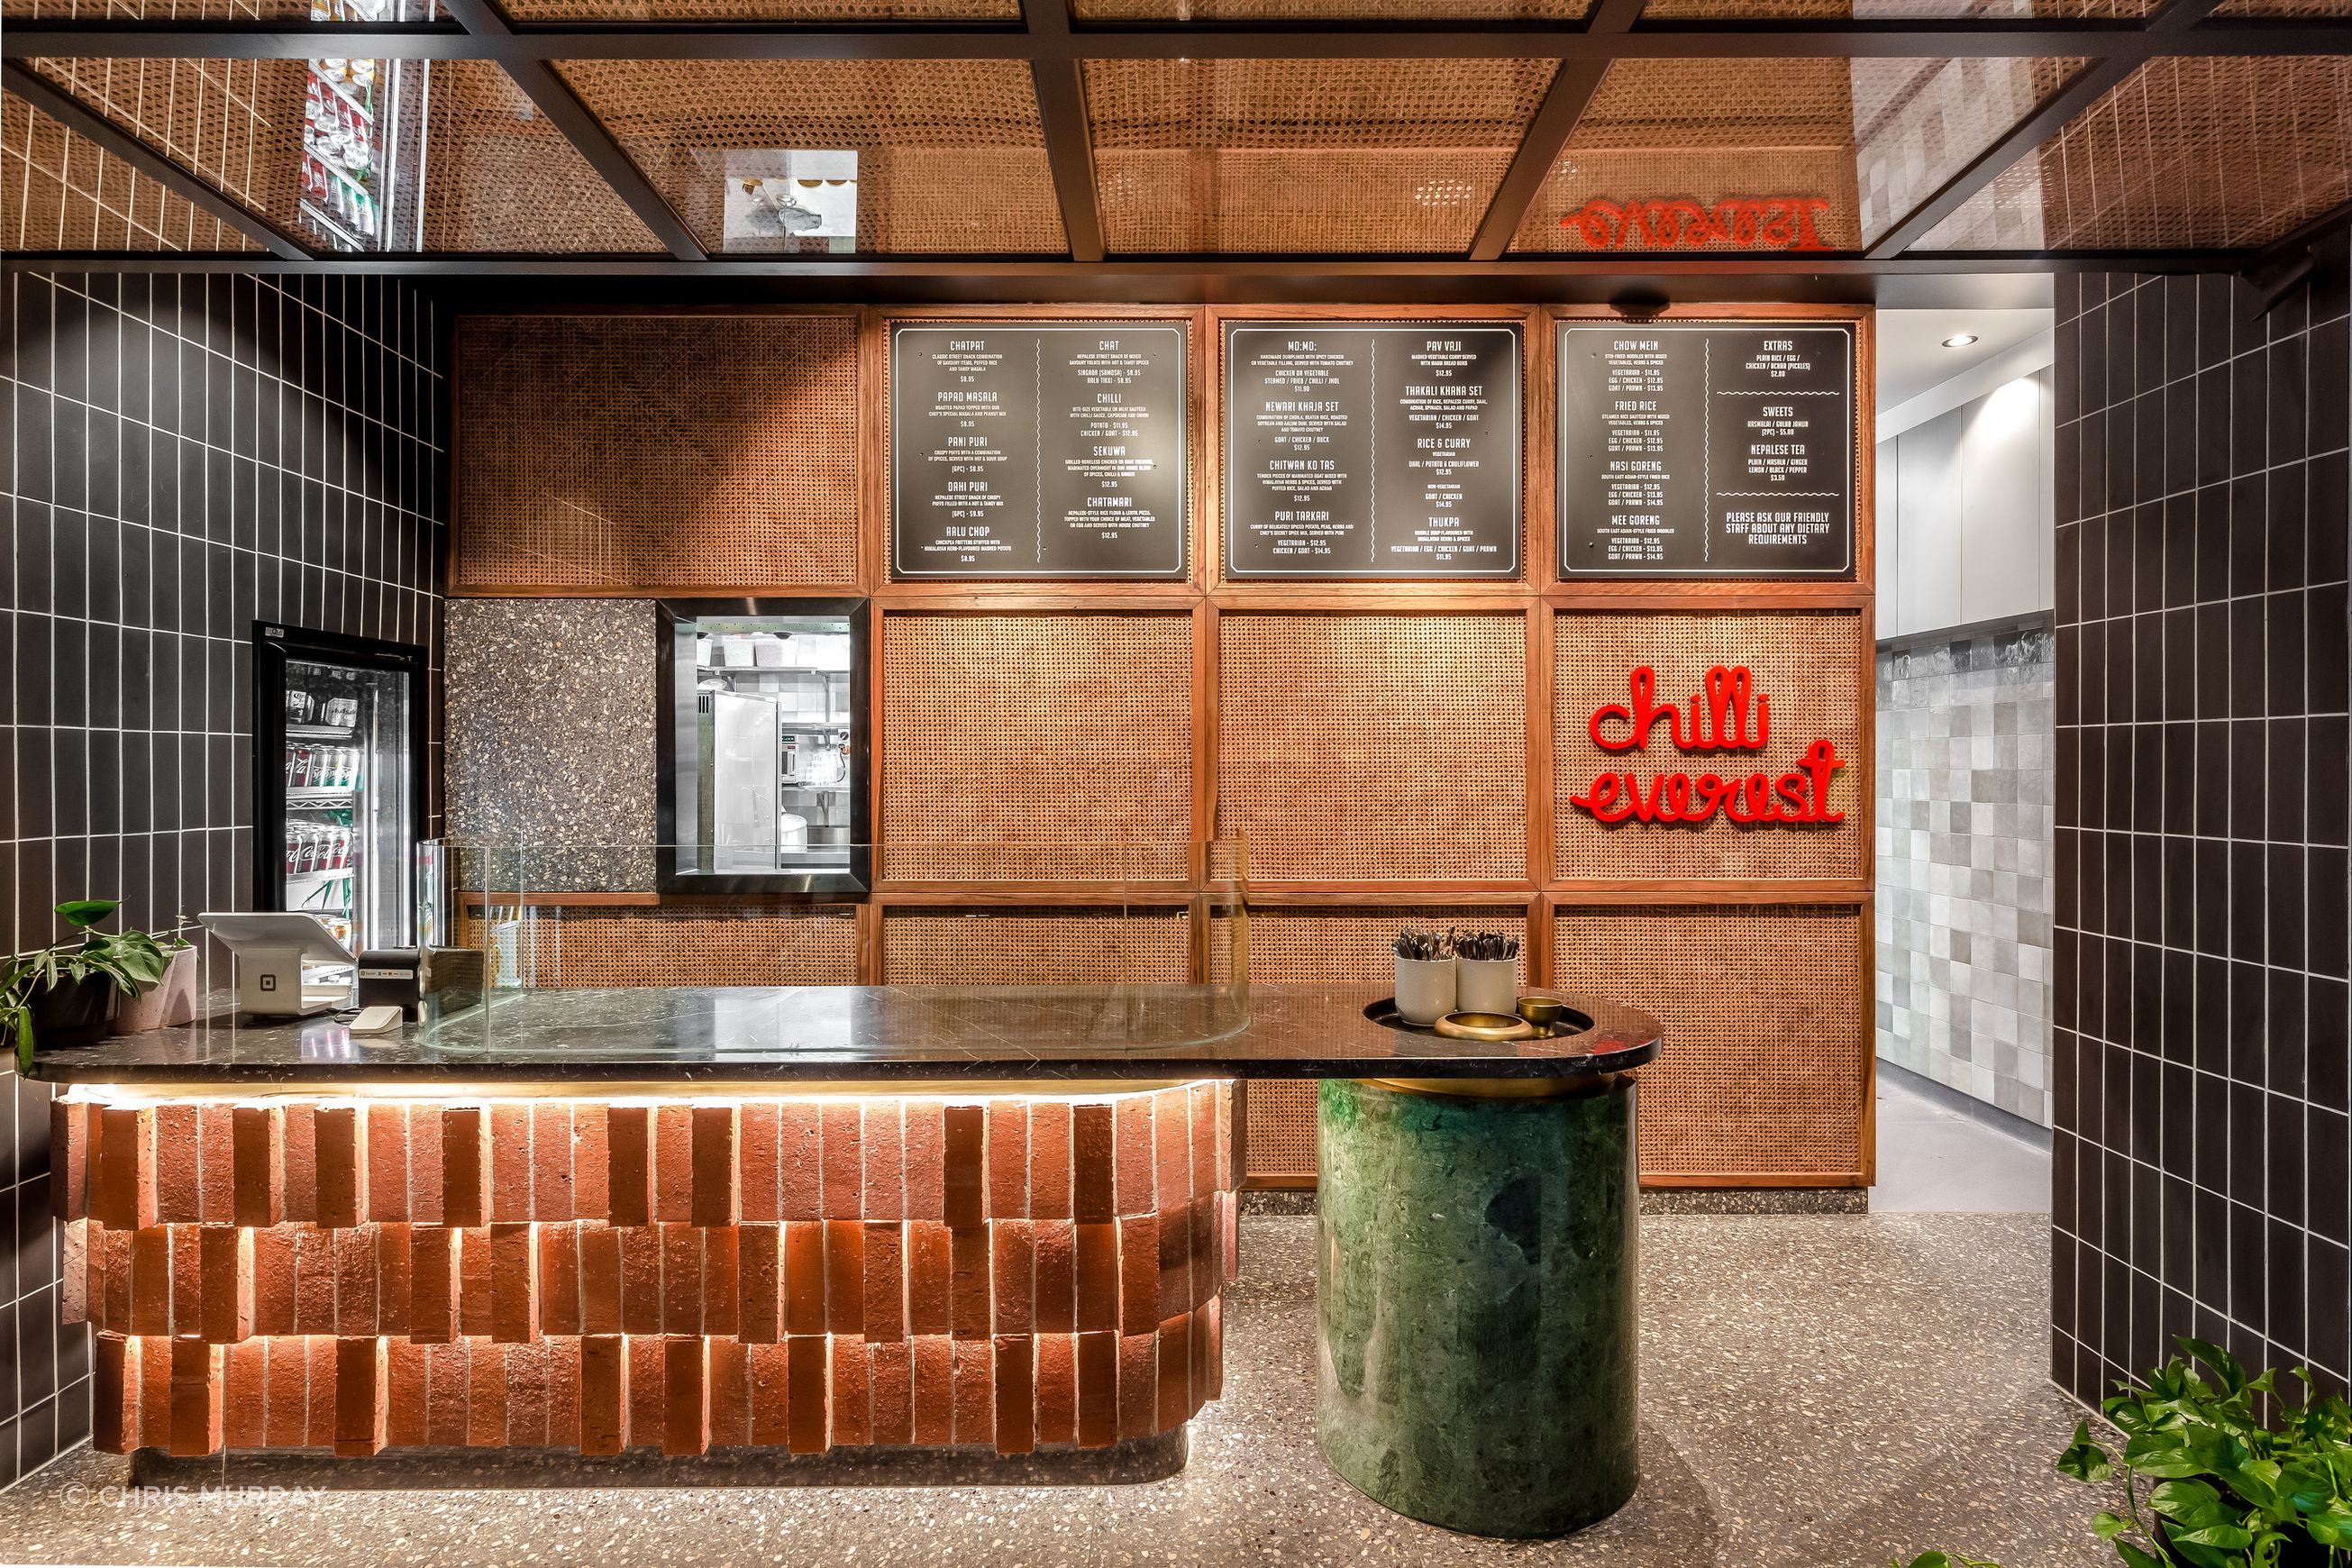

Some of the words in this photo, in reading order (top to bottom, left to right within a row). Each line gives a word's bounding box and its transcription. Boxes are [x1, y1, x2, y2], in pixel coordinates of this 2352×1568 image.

[950, 341, 985, 351] CHATPAT
[1099, 341, 1119, 351] CHAT
[1288, 342, 1317, 351] MO:MO:
[1427, 342, 1443, 351] PAV
[1444, 342, 1462, 351] VAJI
[1614, 341, 1637, 351] CHOW
[1639, 341, 1658, 351] MEIN
[1764, 341, 1792, 351] EXTRAS
[1405, 386, 1437, 396] THAKALI
[1440, 386, 1466, 396] KHANA
[1469, 386, 1482, 396] SET
[938, 392, 963, 402] PAPAD
[966, 392, 998, 402] MASALA
[1097, 394, 1121, 404] CHILLI
[1265, 402, 1295, 412] NEWARI
[1298, 402, 1323, 412] KHAJA
[1325, 402, 1339, 412] SET
[1615, 401, 1636, 411] FRIED
[1639, 401, 1657, 411] RICE
[1763, 406, 1793, 416] SWEETS
[948, 437, 966, 447] PANI
[969, 437, 988, 447] PURI
[1418, 438, 1435, 448] RICE
[1437, 438, 1443, 448] &
[1445, 438, 1471, 448] CURRY
[1093, 446, 1126, 456] SEKUWA
[1751, 444, 1789, 454] NEPALESE
[1791, 444, 1805, 454] TEA
[1270, 460, 1305, 470] CHITWAN
[1308, 460, 1317, 470] KO
[1320, 460, 1335, 470] TAS
[1610, 461, 1628, 471] NASI
[1631, 461, 1662, 471] GORENG
[948, 482, 967, 492] DAHI
[969, 482, 988, 492] PURI
[1087, 497, 1132, 507] CHATAMARI
[1275, 511, 1293, 521] PURI
[1296, 511, 1329, 521] TARKARI
[1611, 515, 1627, 525] MEE
[1629, 515, 1660, 525] GORENG
[1727, 512, 1755, 522] PLEASE
[1756, 512, 1773, 522] ASK
[1774, 512, 1791, 522] OUR
[1793, 512, 1829, 522] FRIENDLY
[1428, 517, 1460, 527] THUKPA
[946, 526, 966, 536] AALU
[969, 526, 990, 536] CHOP
[1726, 524, 1749, 533] STAFF
[1752, 524, 1777, 533] ABOUT
[1780, 524, 1795, 533] ANY
[1798, 524, 1830, 533] DIETARY
[1748, 534, 1807, 544] REQUIREMENTS
[1589, 665, 1769, 750] chilli
[1569, 739, 1846, 823] everest
